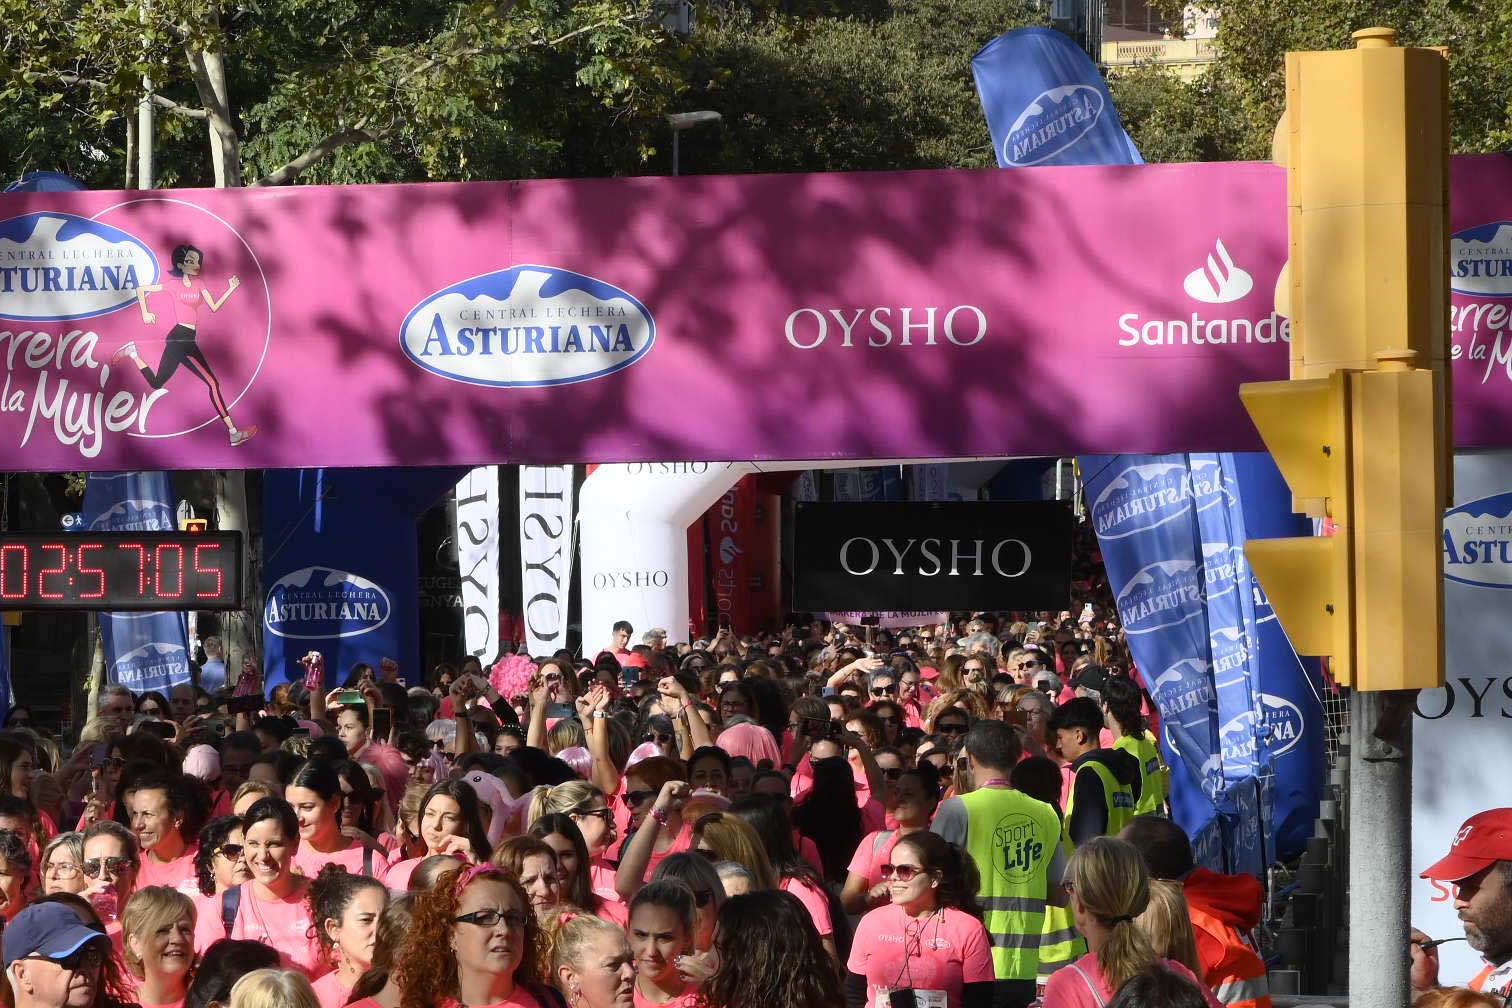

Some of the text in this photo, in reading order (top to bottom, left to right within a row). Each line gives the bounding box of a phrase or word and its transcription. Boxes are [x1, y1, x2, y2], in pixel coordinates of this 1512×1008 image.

[62, 249, 136, 260] LECHERA
[460, 306, 627, 320] CENTRAL LECHERA
[785, 305, 988, 349] OYSHO
[419, 312, 635, 356] ASTURIANA
[1119, 312, 1291, 346] Santande
[1468, 333, 1486, 360] la
[1, 373, 26, 412] la
[20, 366, 169, 458] Mujer
[839, 537, 1032, 577] OYSHO
[593, 569, 669, 590] OYSHO
[269, 596, 381, 623] ASTURIANA
[995, 819, 1036, 848] Sport
[1002, 835, 1044, 872] Life
